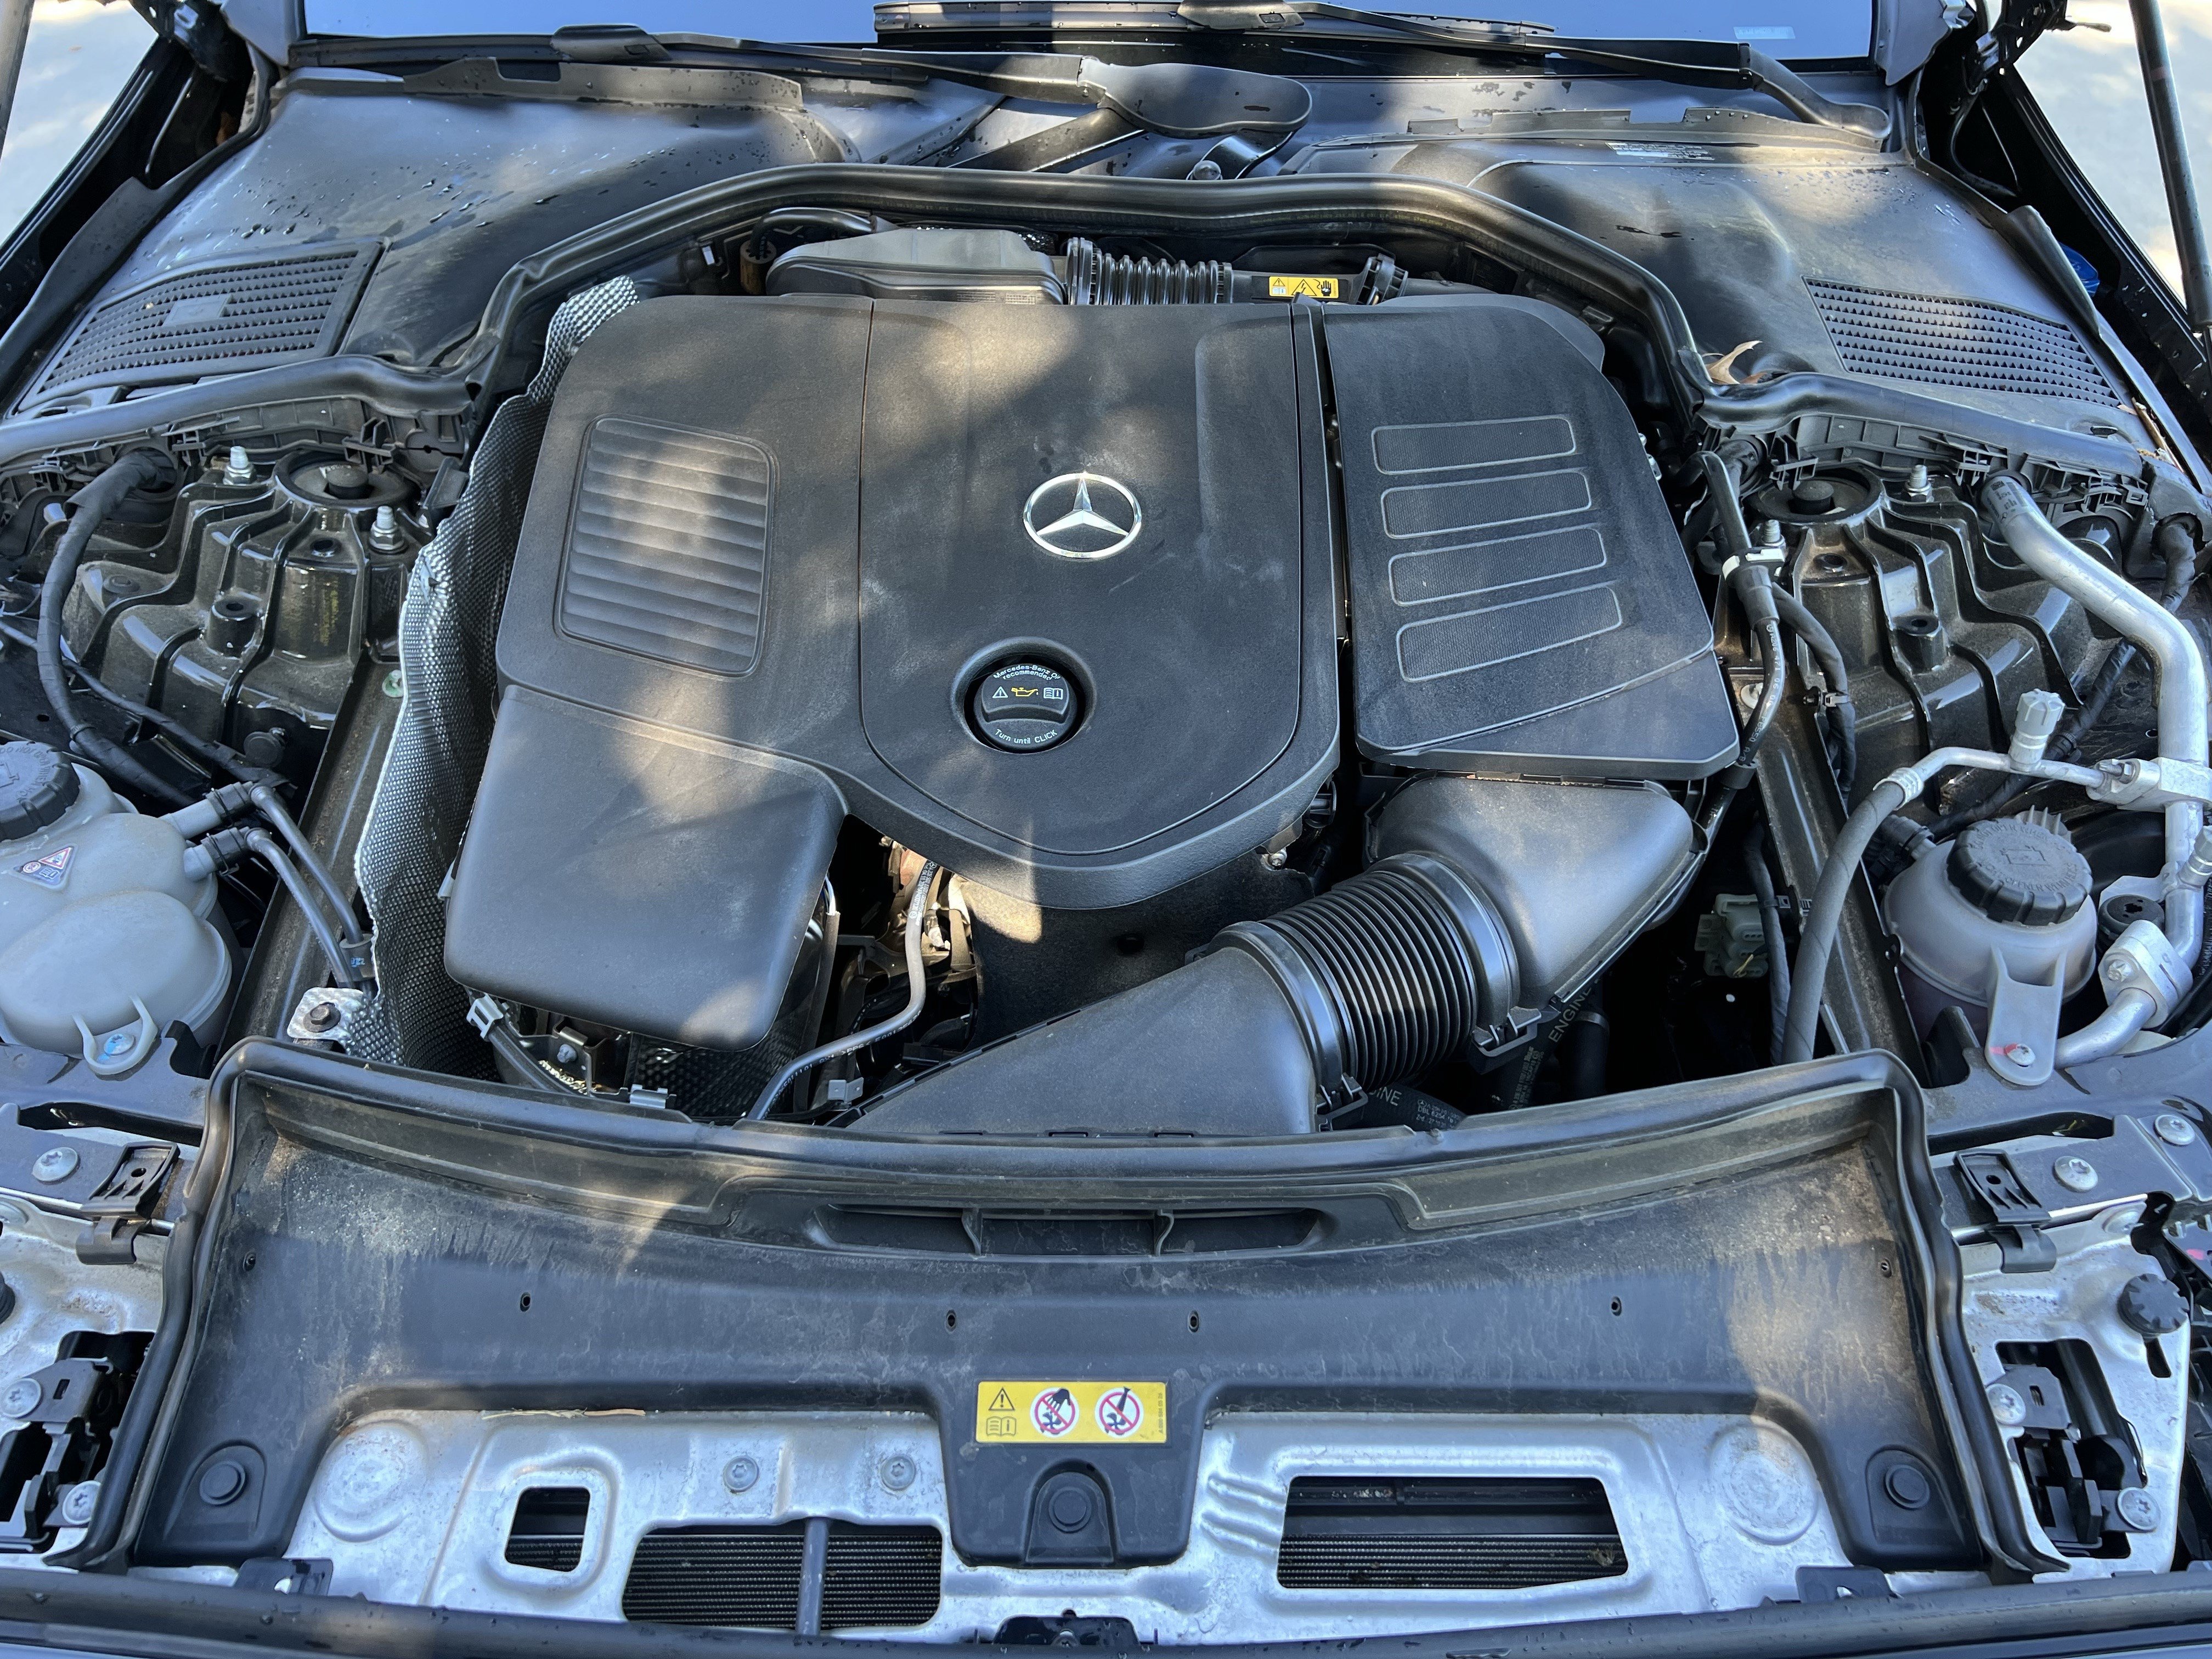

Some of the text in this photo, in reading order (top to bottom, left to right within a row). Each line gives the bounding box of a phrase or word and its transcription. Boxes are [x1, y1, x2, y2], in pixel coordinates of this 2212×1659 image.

[993, 664, 1062, 680] Mercedes-Benz Oil
[1003, 670, 1053, 681] recommended
[995, 729, 1011, 742] Turn
[1034, 729, 1058, 743] CLICK
